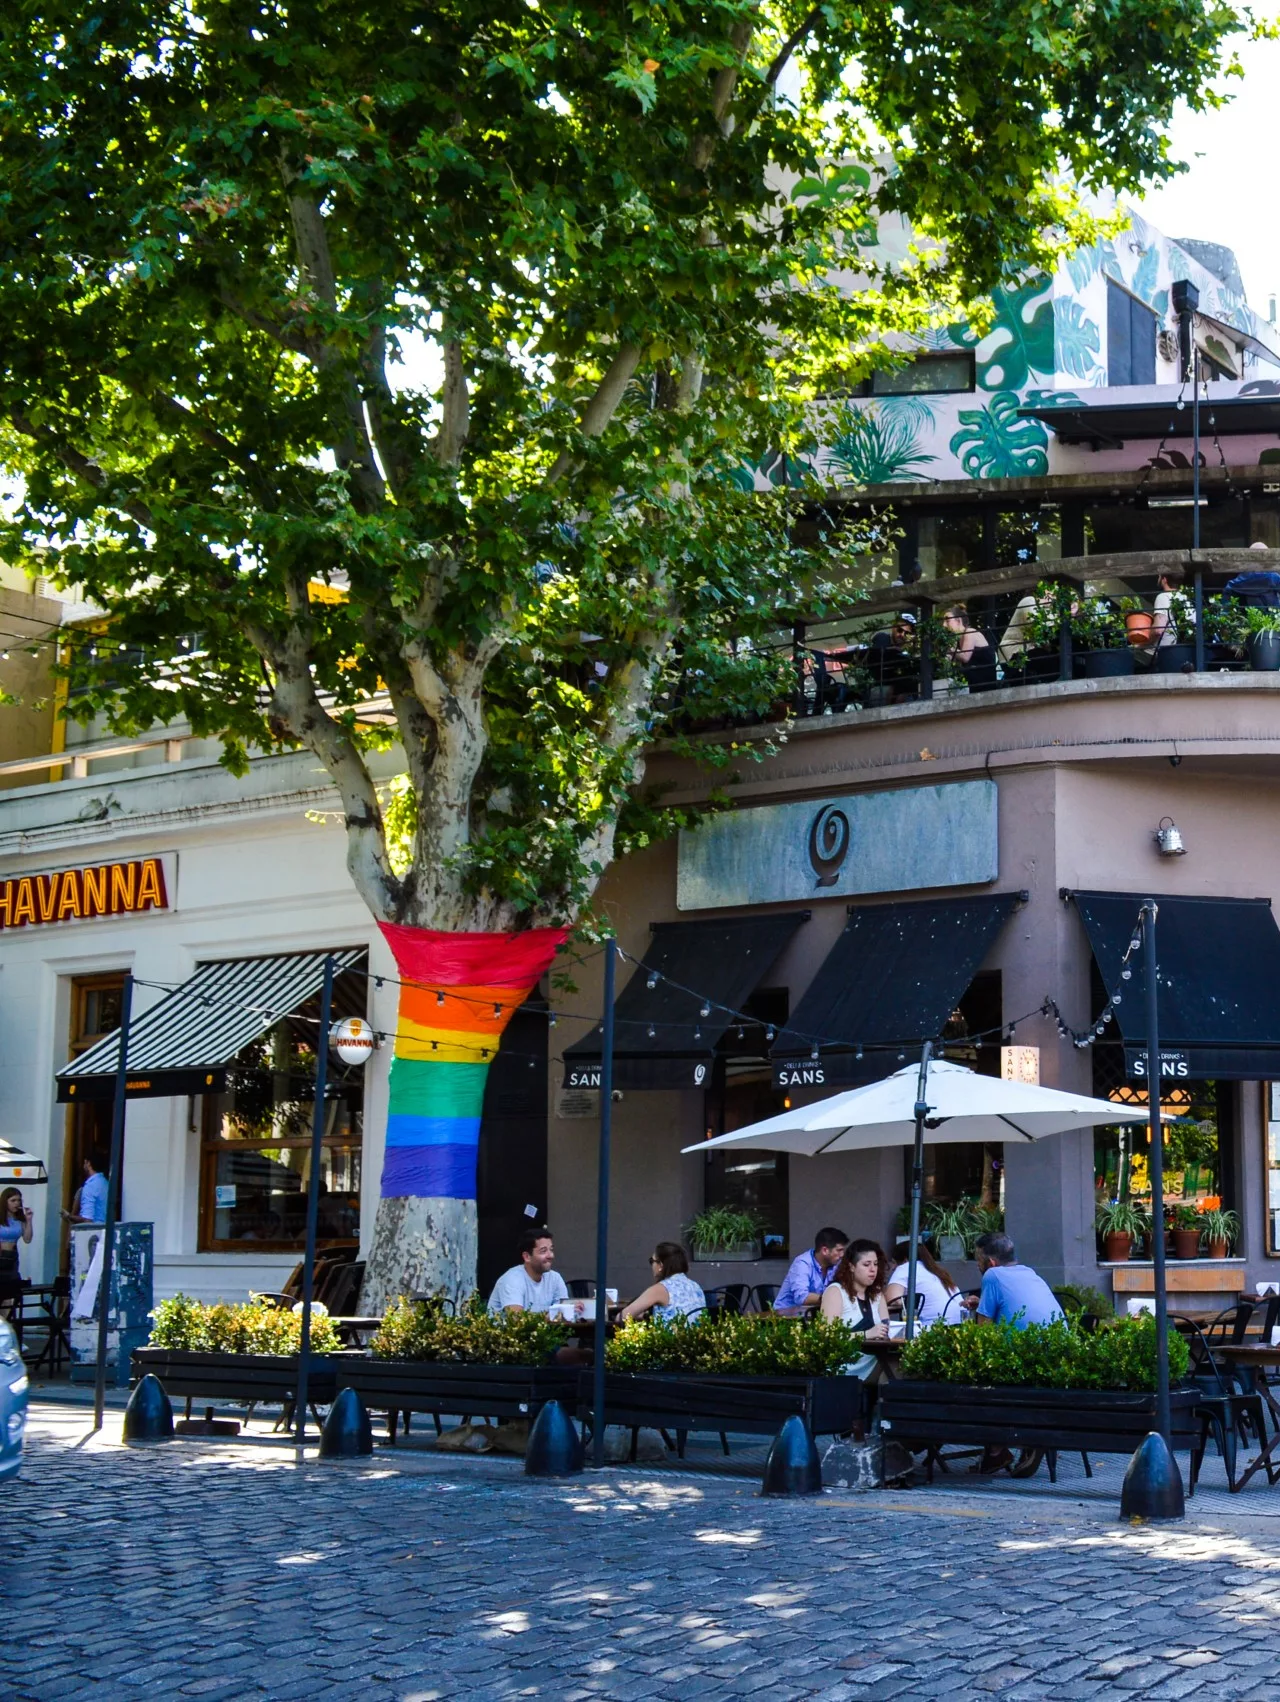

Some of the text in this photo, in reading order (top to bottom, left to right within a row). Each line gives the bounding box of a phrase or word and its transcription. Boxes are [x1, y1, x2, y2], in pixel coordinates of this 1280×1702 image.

[336, 1038, 374, 1048] HAVANNA
[1133, 1061, 1188, 1077] SNS
[569, 1073, 601, 1086] SAN
[779, 1070, 825, 1085] SANS
